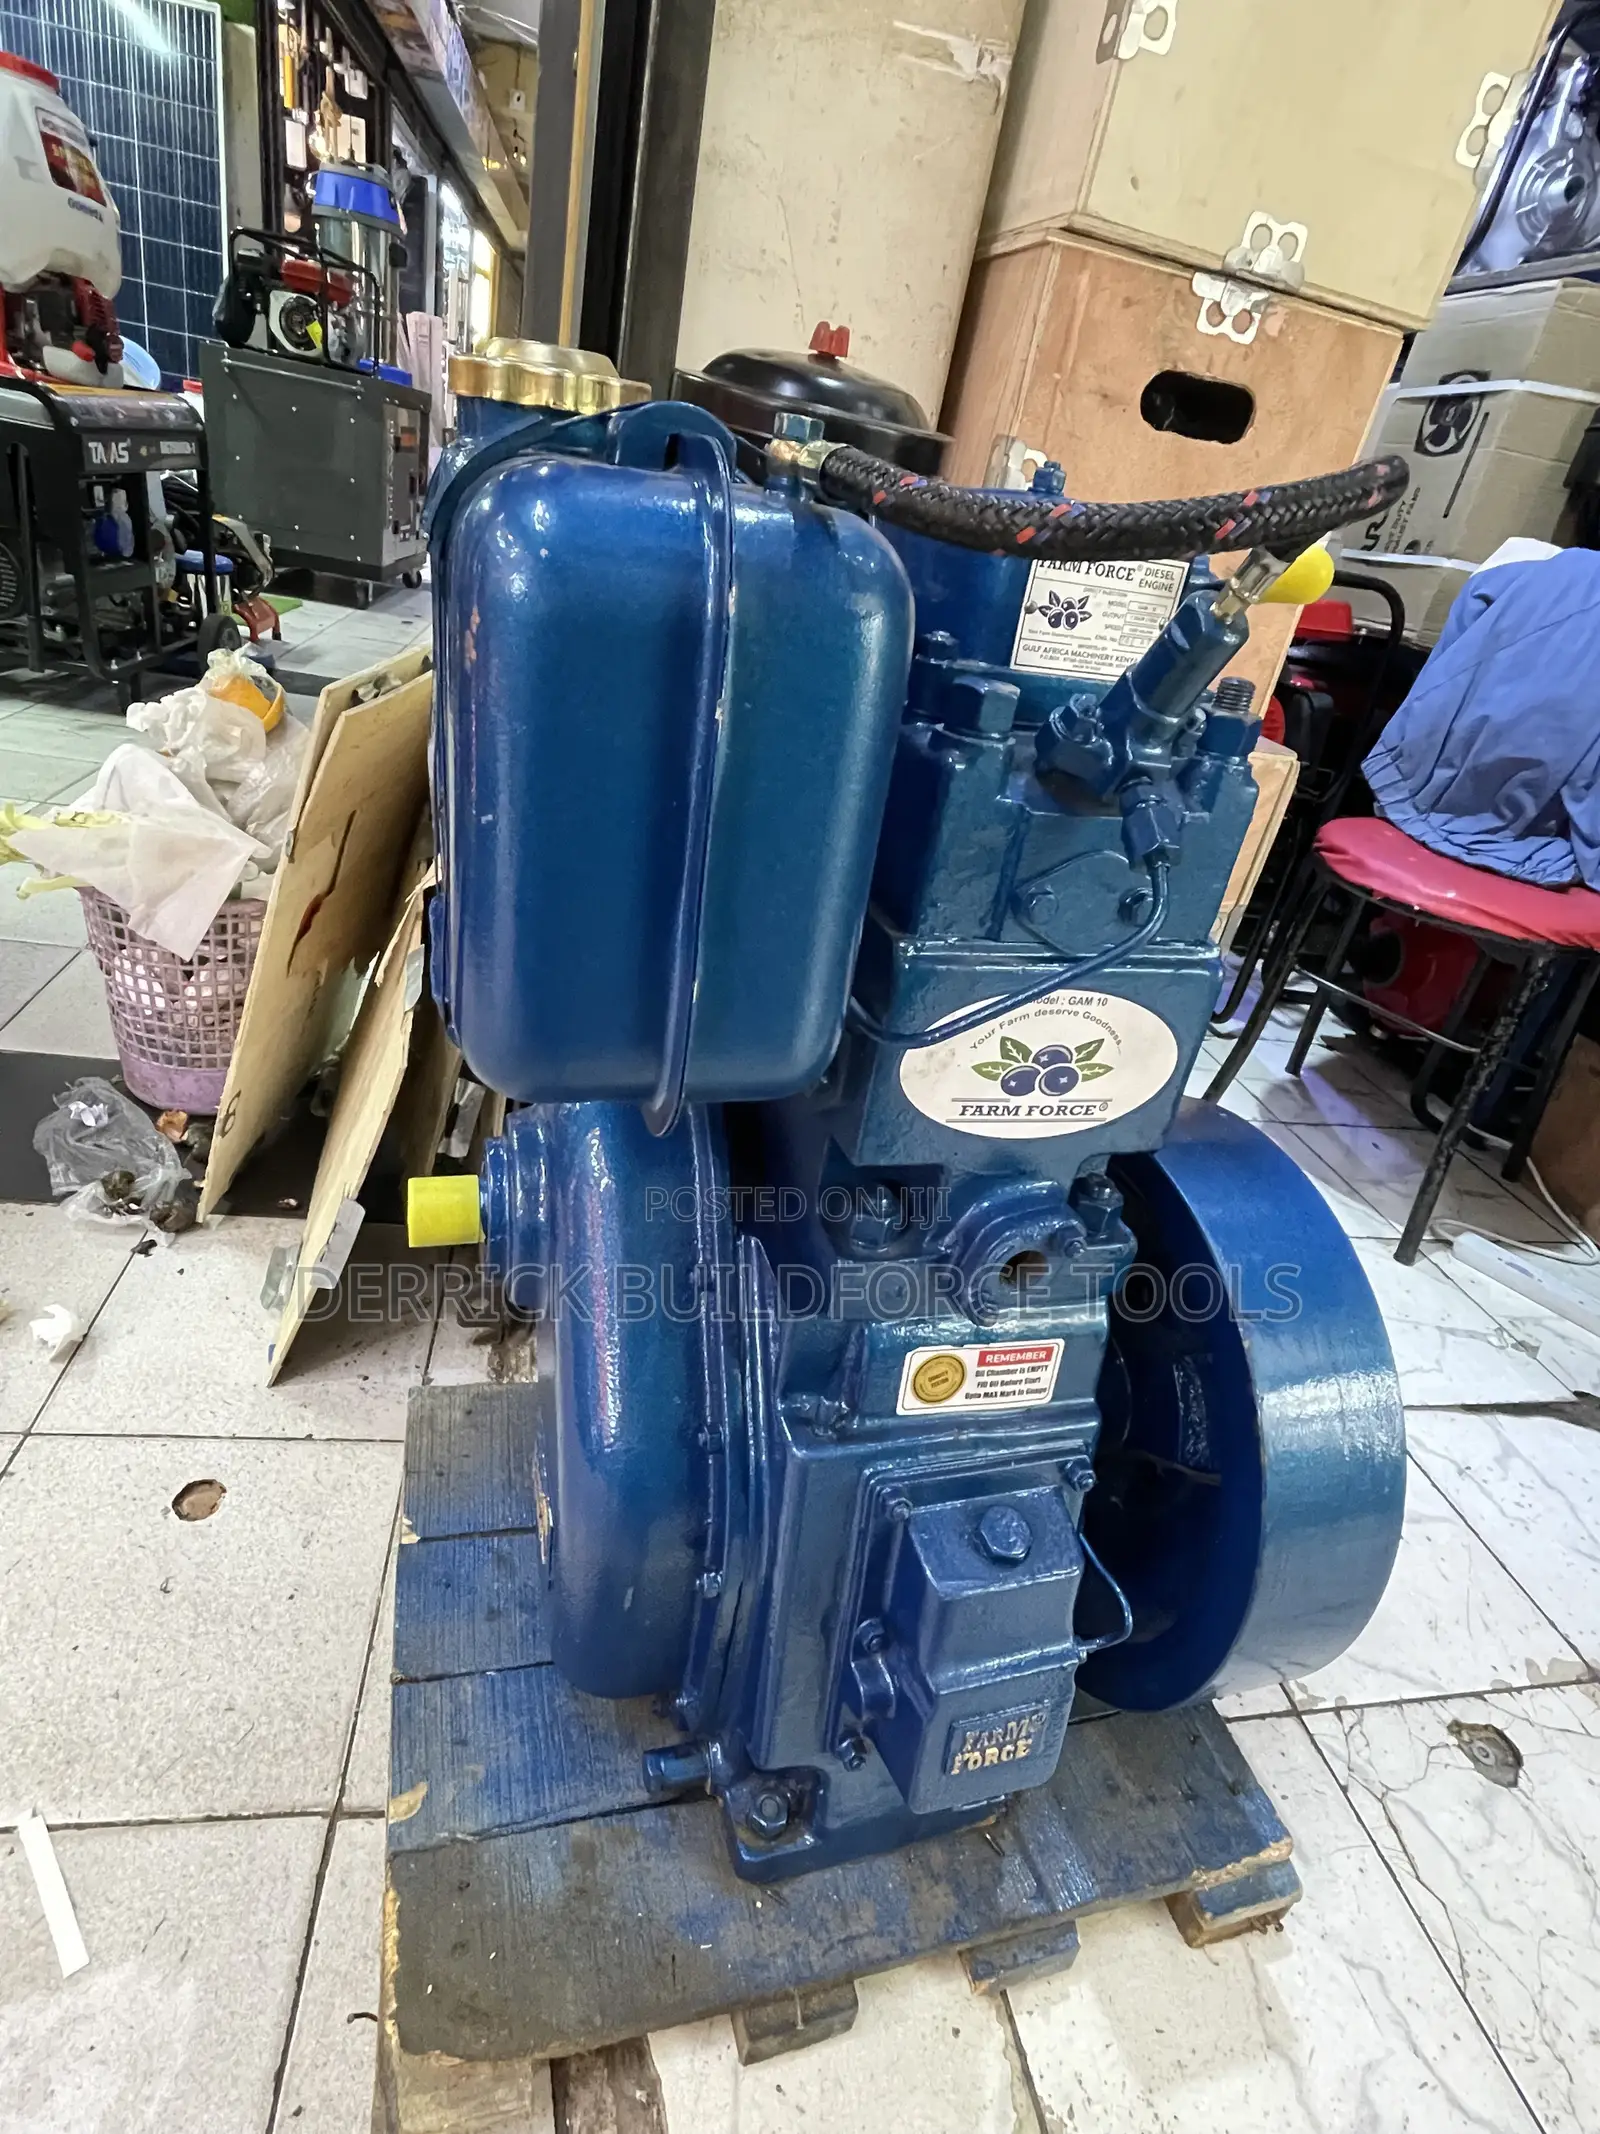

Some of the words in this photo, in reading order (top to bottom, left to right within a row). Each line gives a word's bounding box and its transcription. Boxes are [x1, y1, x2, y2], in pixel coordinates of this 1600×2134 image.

[1144, 567, 1176, 581] DIESEL
[1139, 580, 1174, 593] ENGINE
[1022, 644, 1041, 653] GULF
[1042, 646, 1069, 657] AFRICA
[1070, 650, 1114, 661] MACHINERY
[1031, 995, 1060, 1005] odel
[1068, 996, 1094, 1006] GAM
[1096, 997, 1108, 1007] 10
[970, 1028, 996, 1050] Your
[999, 1013, 1030, 1030] Farm
[1034, 1008, 1080, 1018] deserve
[958, 1104, 1021, 1117] FARM
[985, 1351, 1047, 1363] REMEMBER
[1027, 1365, 1049, 1374] EMPTY
[983, 1391, 998, 1399] MAX
[999, 1389, 1016, 1398] Mark
[950, 1738, 1033, 1775] FORCE
